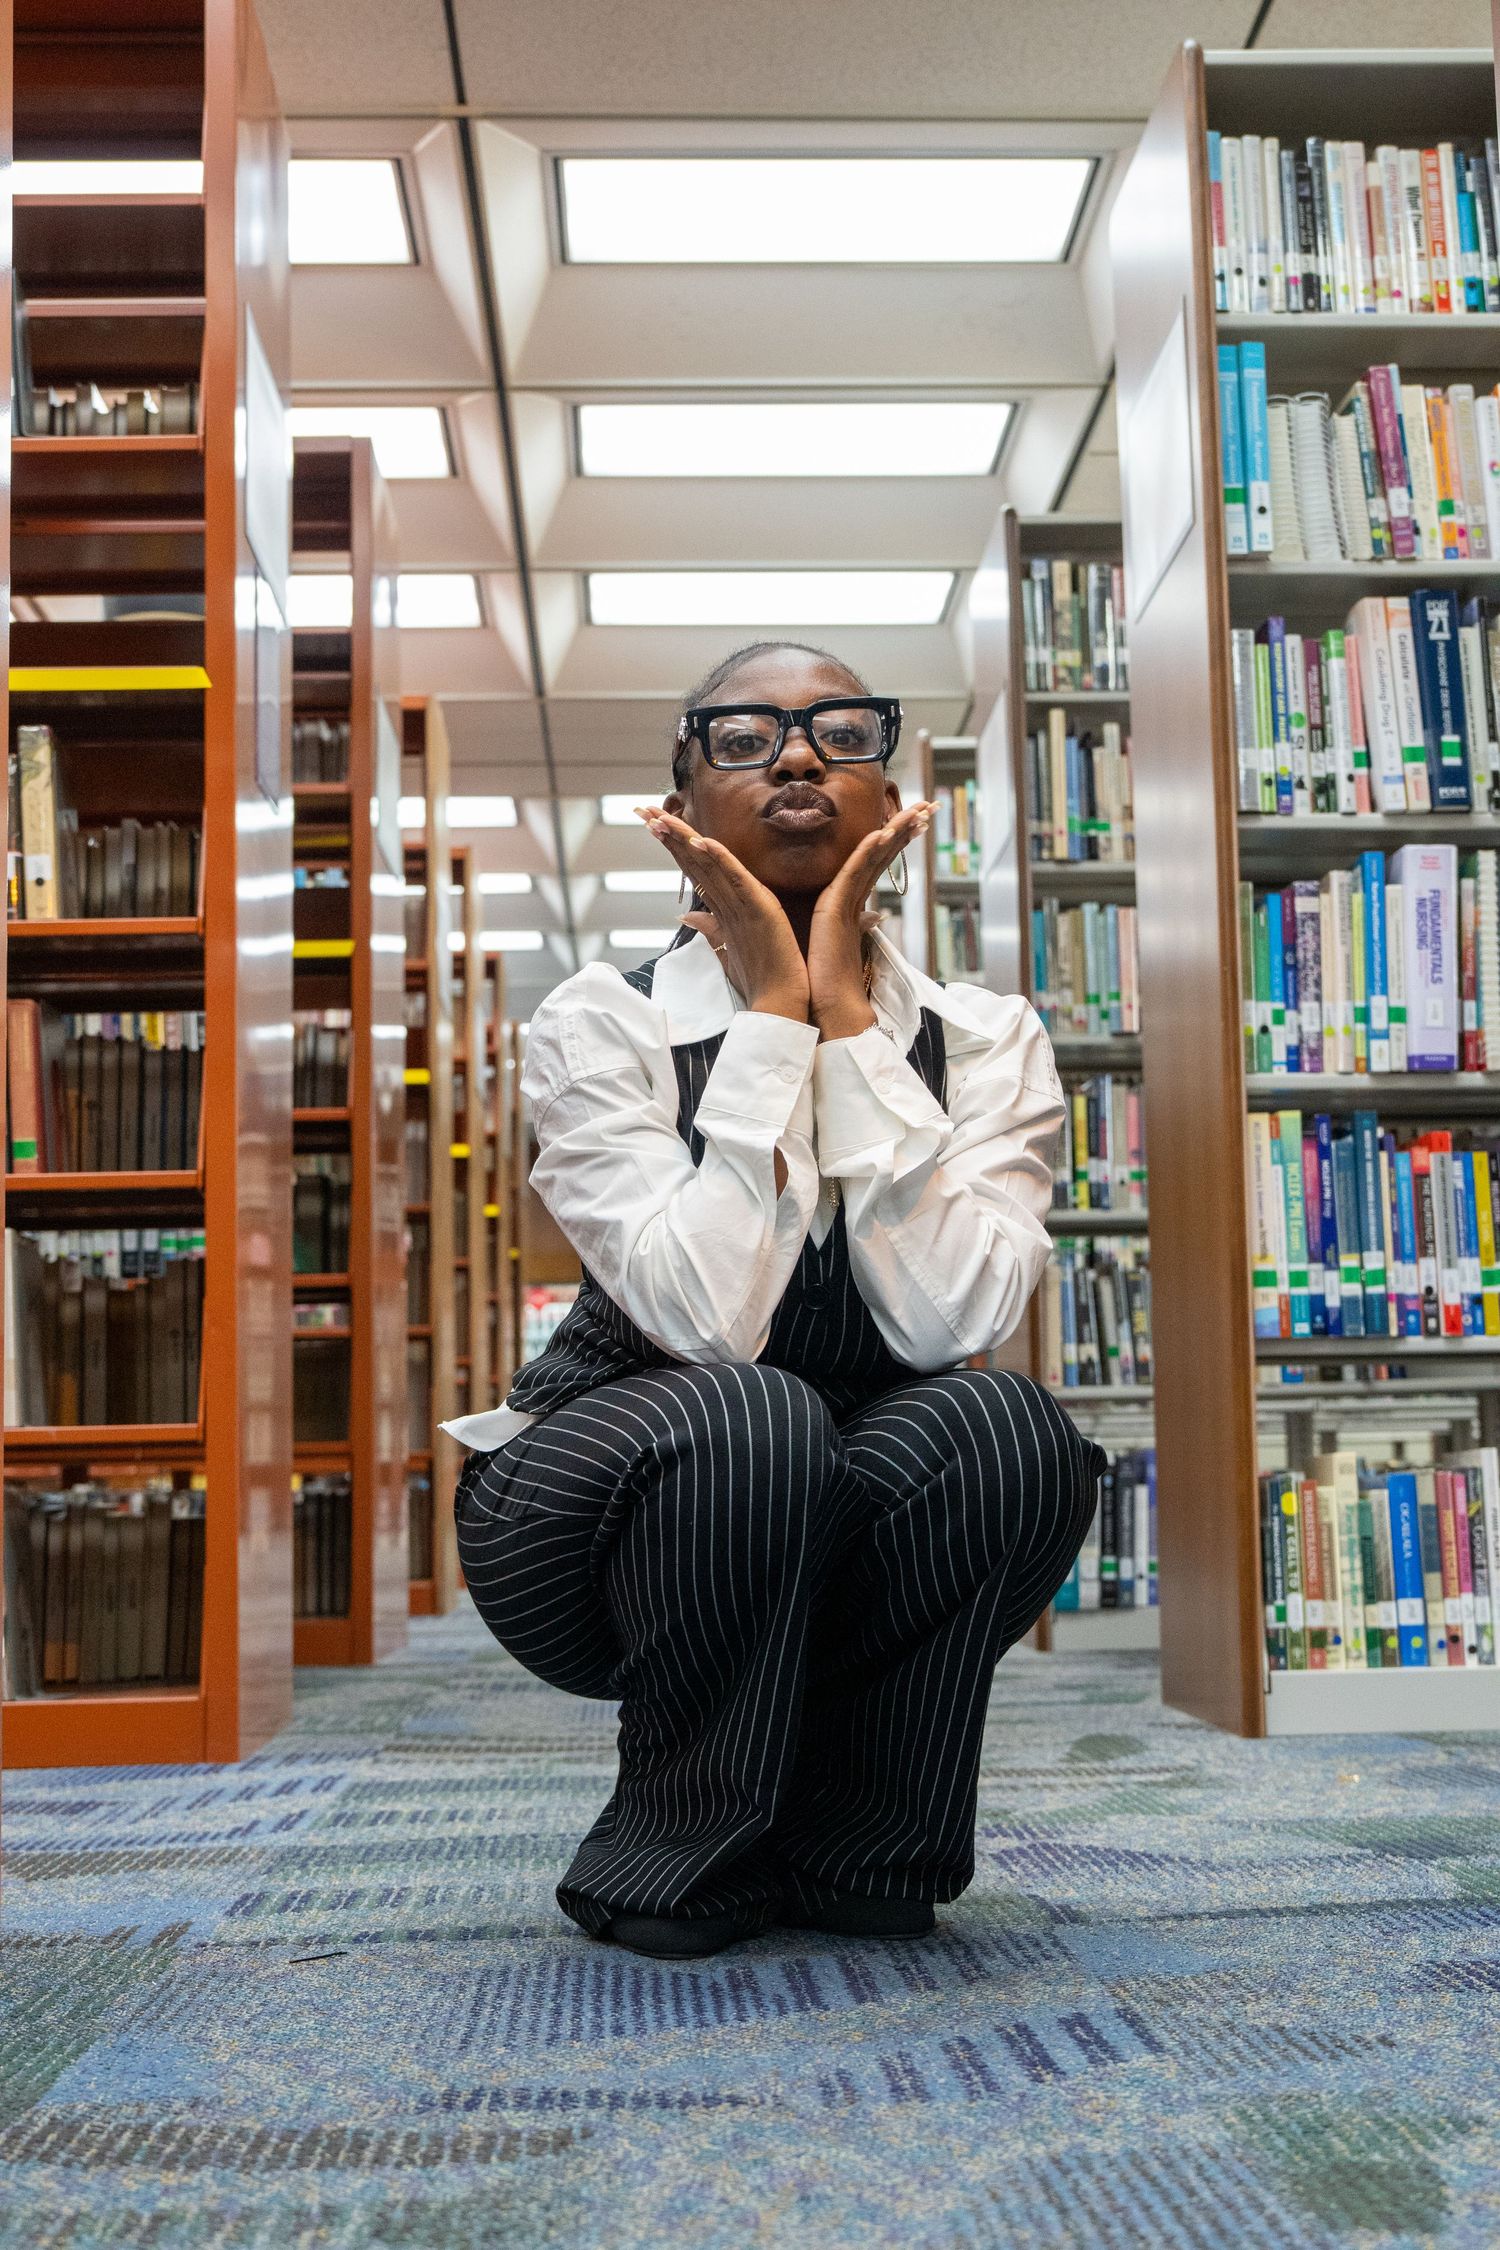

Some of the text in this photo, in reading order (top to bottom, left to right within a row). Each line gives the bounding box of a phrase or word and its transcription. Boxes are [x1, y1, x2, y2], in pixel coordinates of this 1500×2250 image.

[1405, 185, 1420, 210] What
[1398, 634, 1411, 680] Calculate
[1415, 897, 1427, 950] NURSING
[1429, 889, 1443, 984] FUNDAMENTALS
[1422, 1177, 1430, 1196] THE
[1423, 1197, 1433, 1241] NURSING
[1287, 1537, 1298, 1567] CALL
[1288, 1572, 1299, 1588] TO
